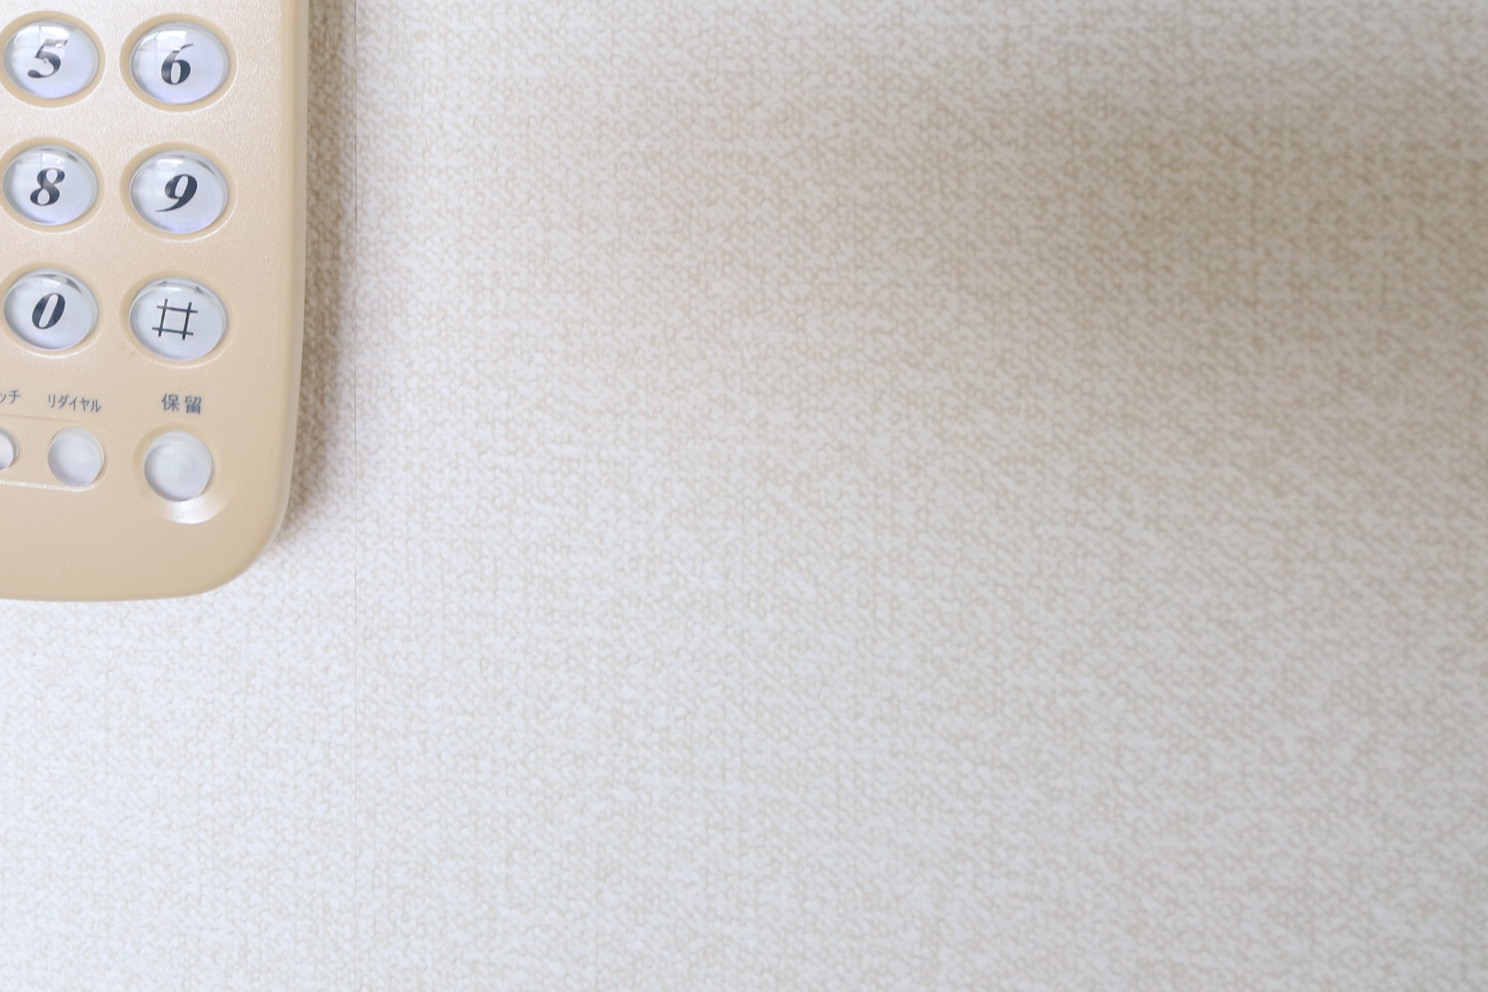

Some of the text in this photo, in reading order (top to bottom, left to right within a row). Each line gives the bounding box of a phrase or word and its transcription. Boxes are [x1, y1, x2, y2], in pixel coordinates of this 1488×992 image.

[27, 39, 68, 79] 5
[160, 43, 193, 86] 6
[29, 168, 66, 207] 8
[155, 173, 198, 212] 9
[31, 292, 66, 330] 0
[47, 393, 102, 413] リダイヤル
[160, 393, 203, 415] 保留
